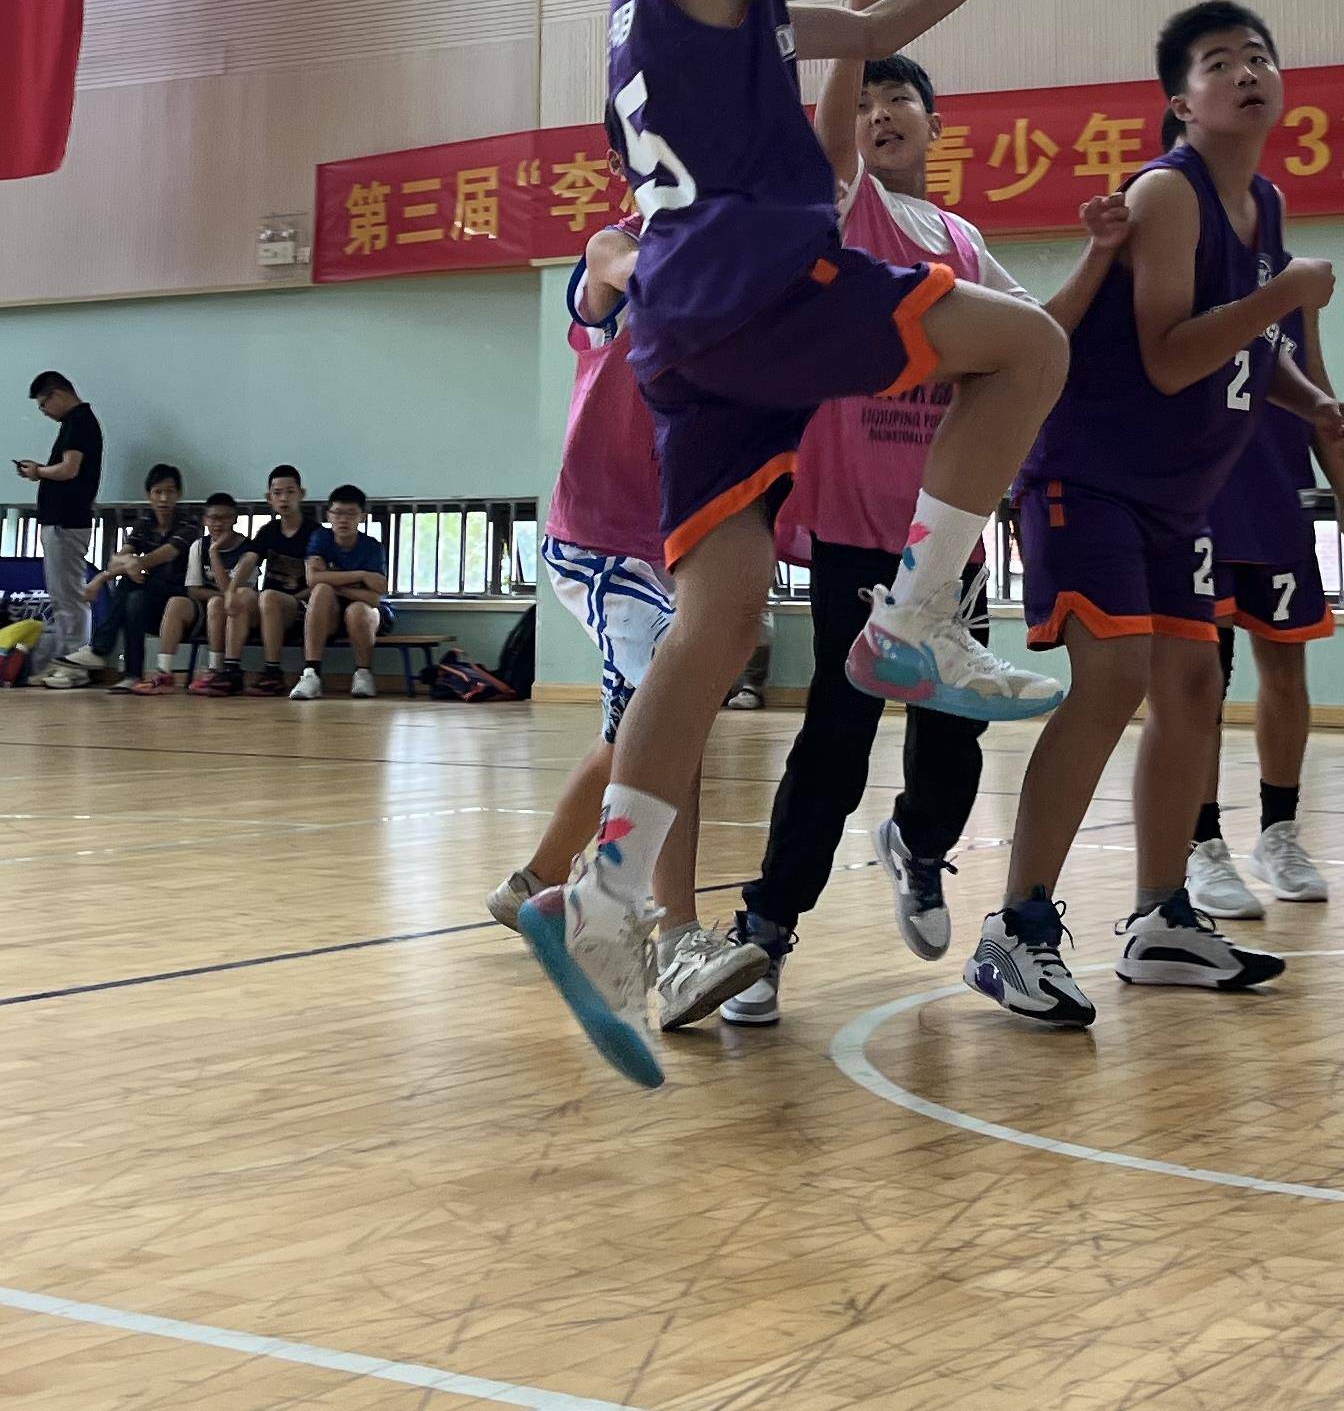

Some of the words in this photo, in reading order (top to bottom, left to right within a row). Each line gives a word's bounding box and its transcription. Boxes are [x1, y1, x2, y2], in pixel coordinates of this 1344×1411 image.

[344, 152, 636, 256] 第三届“李
[1227, 350, 1251, 411] 2
[1193, 537, 1216, 596] 2
[1272, 572, 1297, 622] 7
